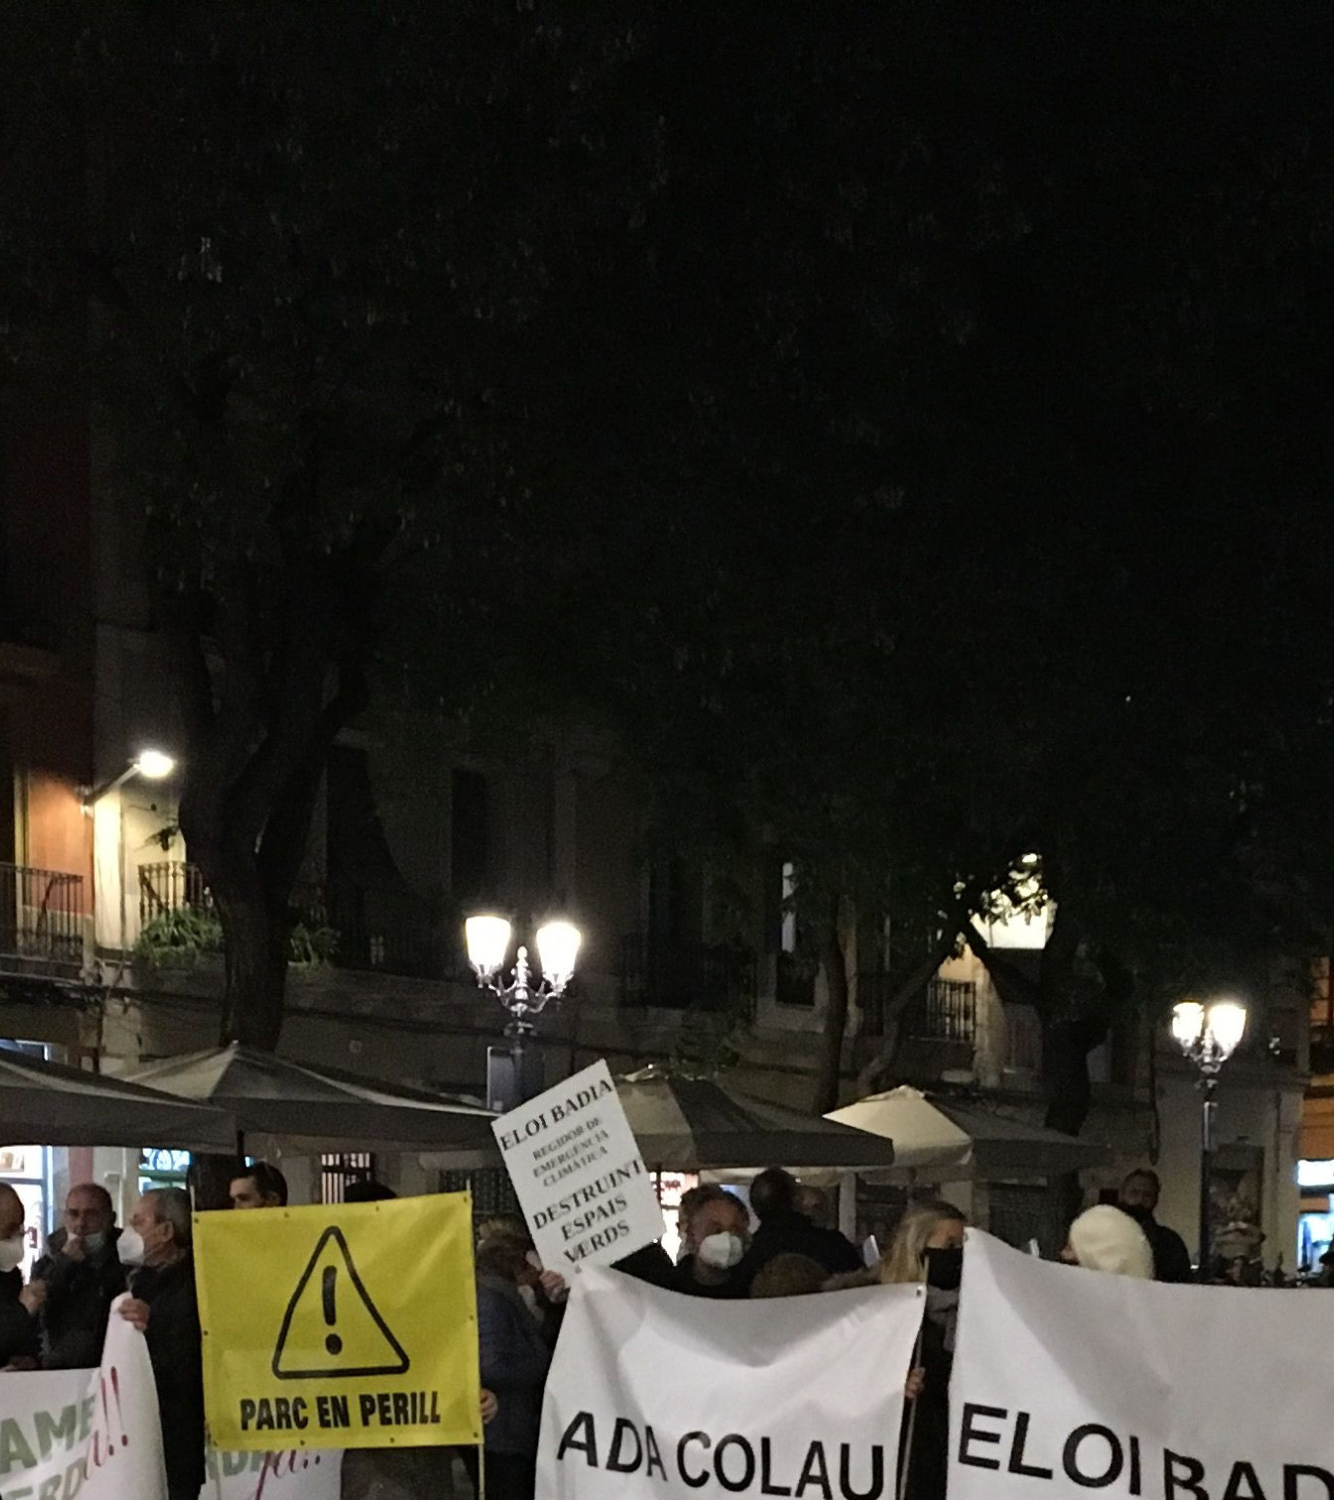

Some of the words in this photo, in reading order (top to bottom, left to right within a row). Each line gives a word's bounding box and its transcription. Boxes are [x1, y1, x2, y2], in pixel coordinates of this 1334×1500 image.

[500, 1113, 548, 1151] ELOI
[551, 1079, 613, 1124] BADIA
[532, 1125, 584, 1160] REGIDOR
[533, 1159, 642, 1230] DESTRUINT
[560, 1194, 628, 1242] ESPAIS
[563, 1219, 630, 1264] VERDS
[240, 1396, 308, 1431] PARC
[315, 1395, 351, 1429] EN
[359, 1390, 441, 1427] PERILL
[556, 1410, 668, 1483] ADA
[958, 1402, 1142, 1497] ELOI
